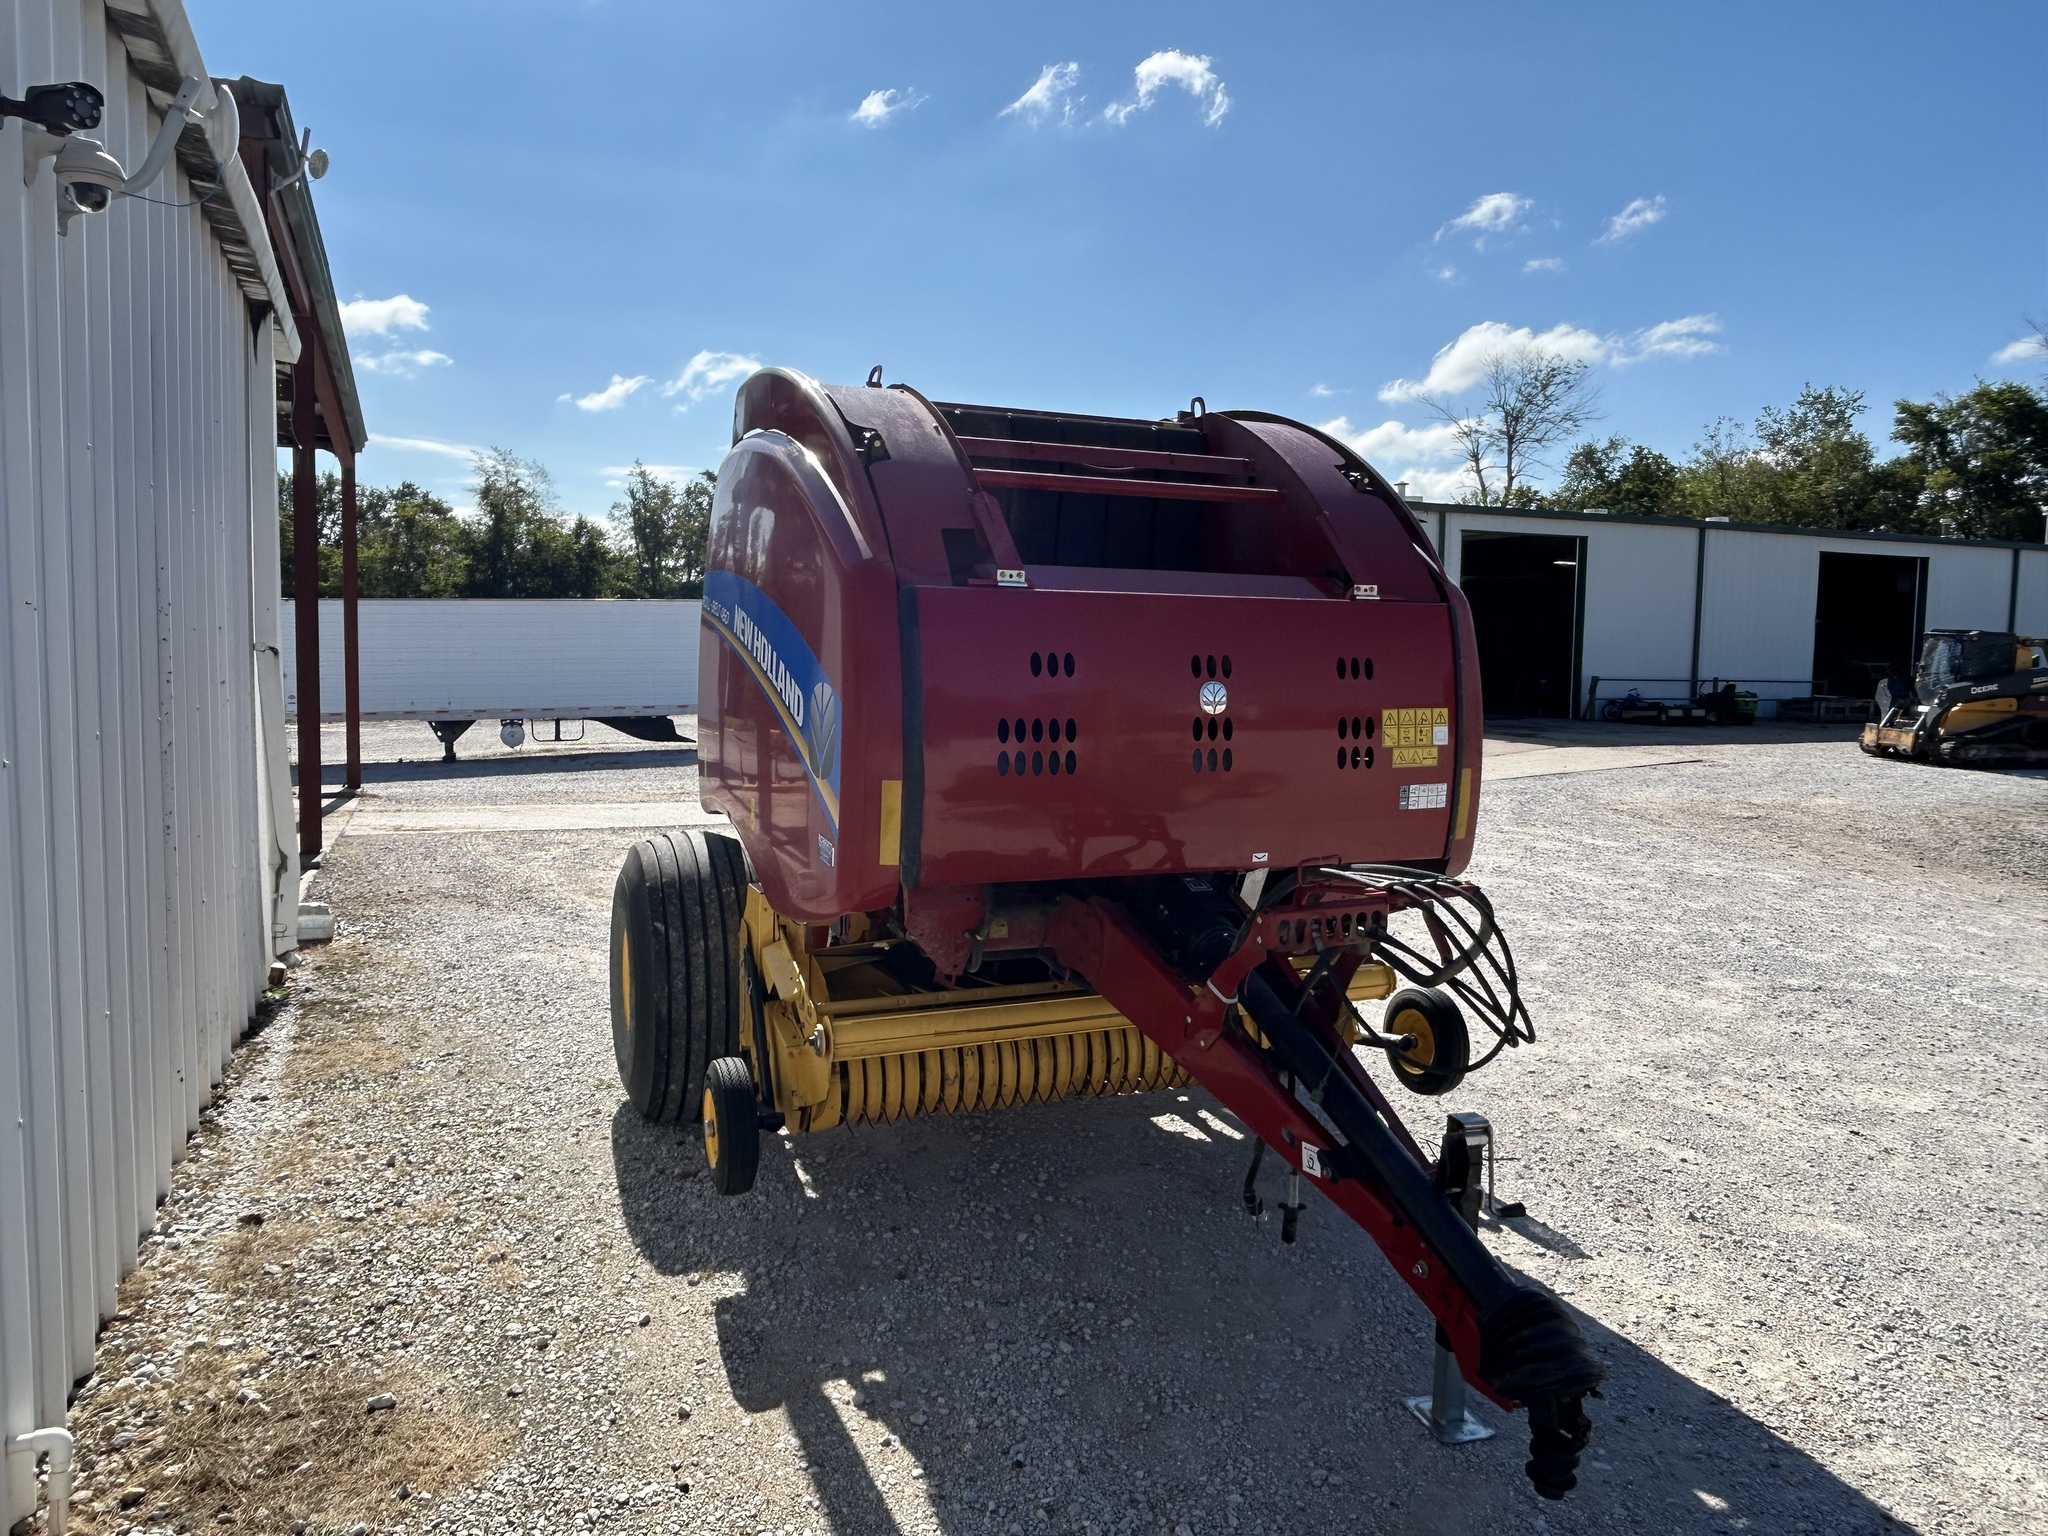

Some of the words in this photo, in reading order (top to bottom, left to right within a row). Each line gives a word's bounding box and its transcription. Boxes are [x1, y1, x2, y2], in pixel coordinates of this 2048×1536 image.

[734, 604, 754, 651] NEW
[753, 625, 804, 727] HOLLAND
[1970, 683, 1998, 694] DEERE
